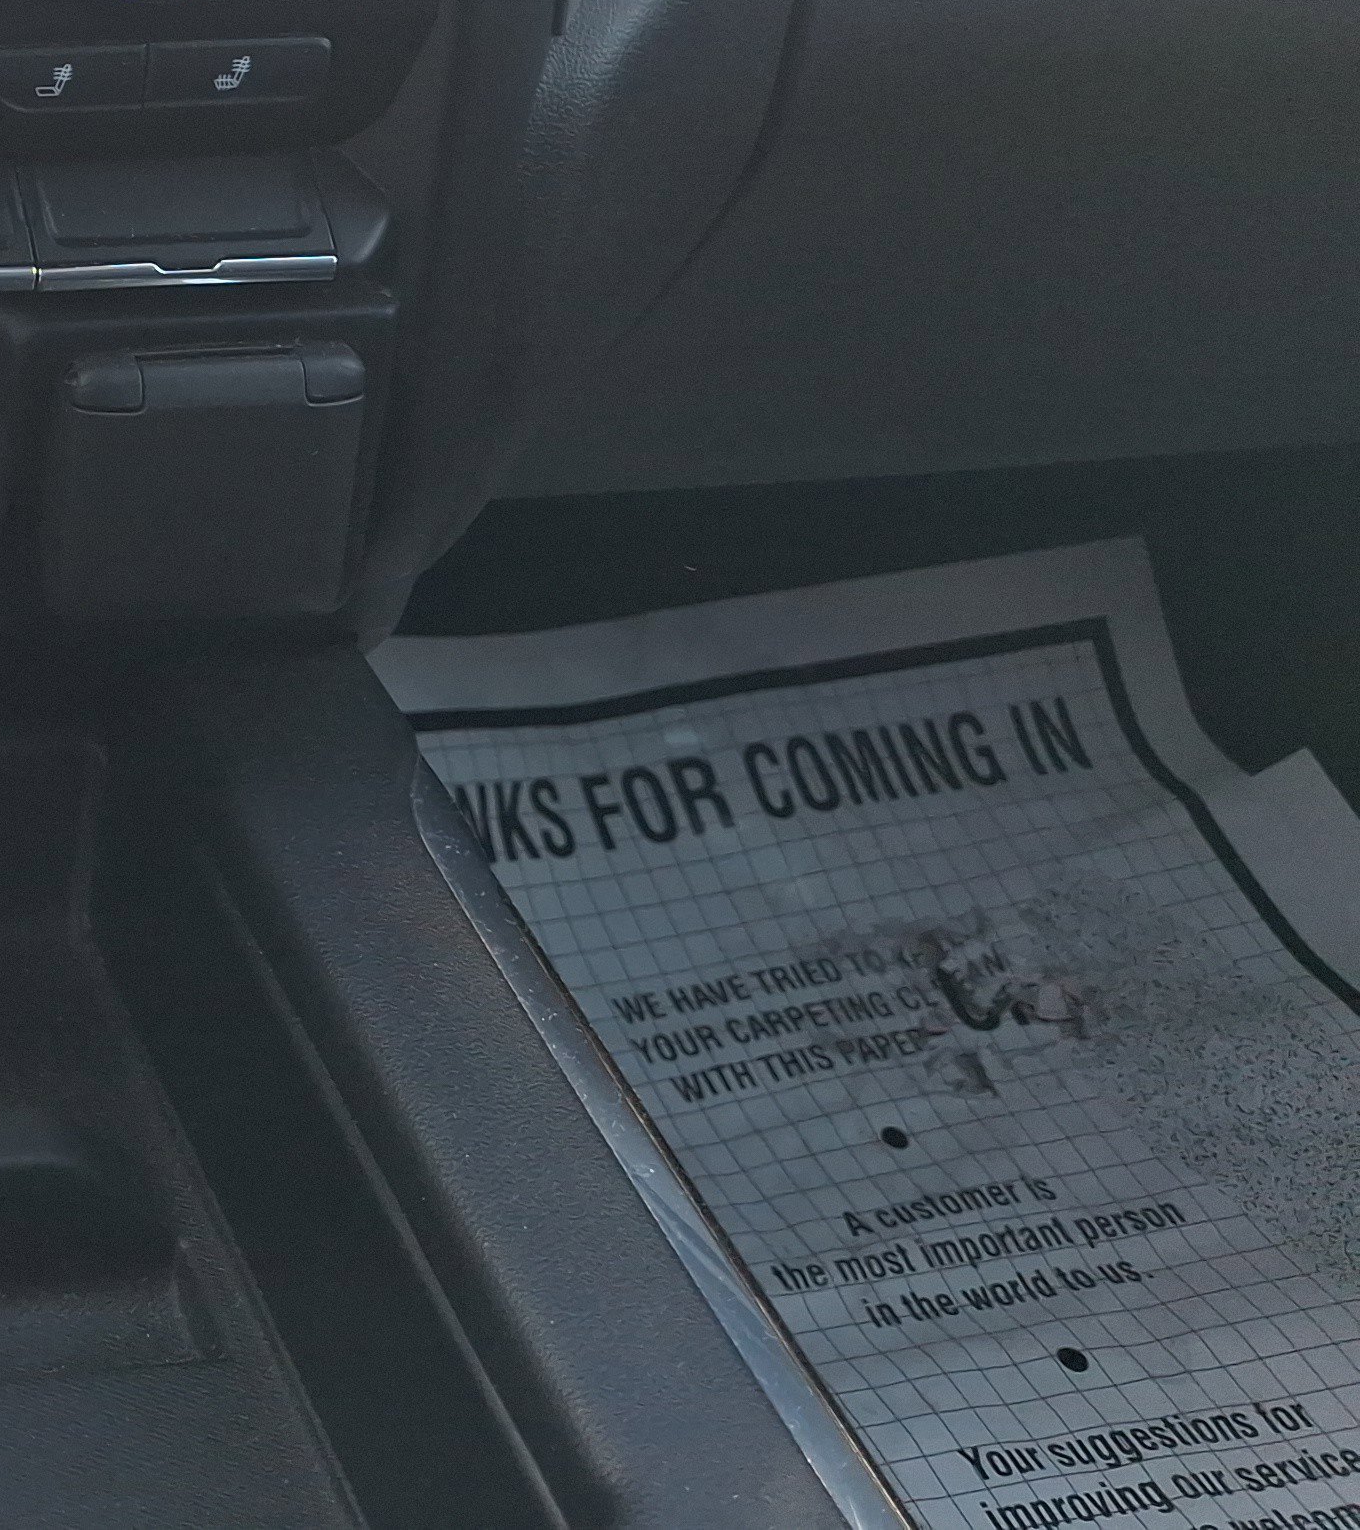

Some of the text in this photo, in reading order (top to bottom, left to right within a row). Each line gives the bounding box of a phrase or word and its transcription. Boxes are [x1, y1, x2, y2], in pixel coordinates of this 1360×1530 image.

[581, 757, 735, 850] FOR
[743, 710, 1007, 820] COMING
[1009, 696, 1094, 776] IN
[614, 994, 667, 1026] WE
[667, 975, 752, 1013] HAVE
[750, 955, 842, 996] TRIED
[630, 1024, 720, 1066] YOUR
[726, 991, 897, 1046] CARPETING
[670, 1062, 757, 1105] WITH
[760, 1040, 832, 1084] THIS
[842, 1174, 1056, 1237] A customer is
[770, 1201, 1186, 1293] the most important person
[862, 1257, 1155, 1330] in the world to us.
[956, 1400, 1314, 1481] Your suggestions for
[1171, 1471, 1233, 1500] our
[1234, 1449, 1360, 1492] service
